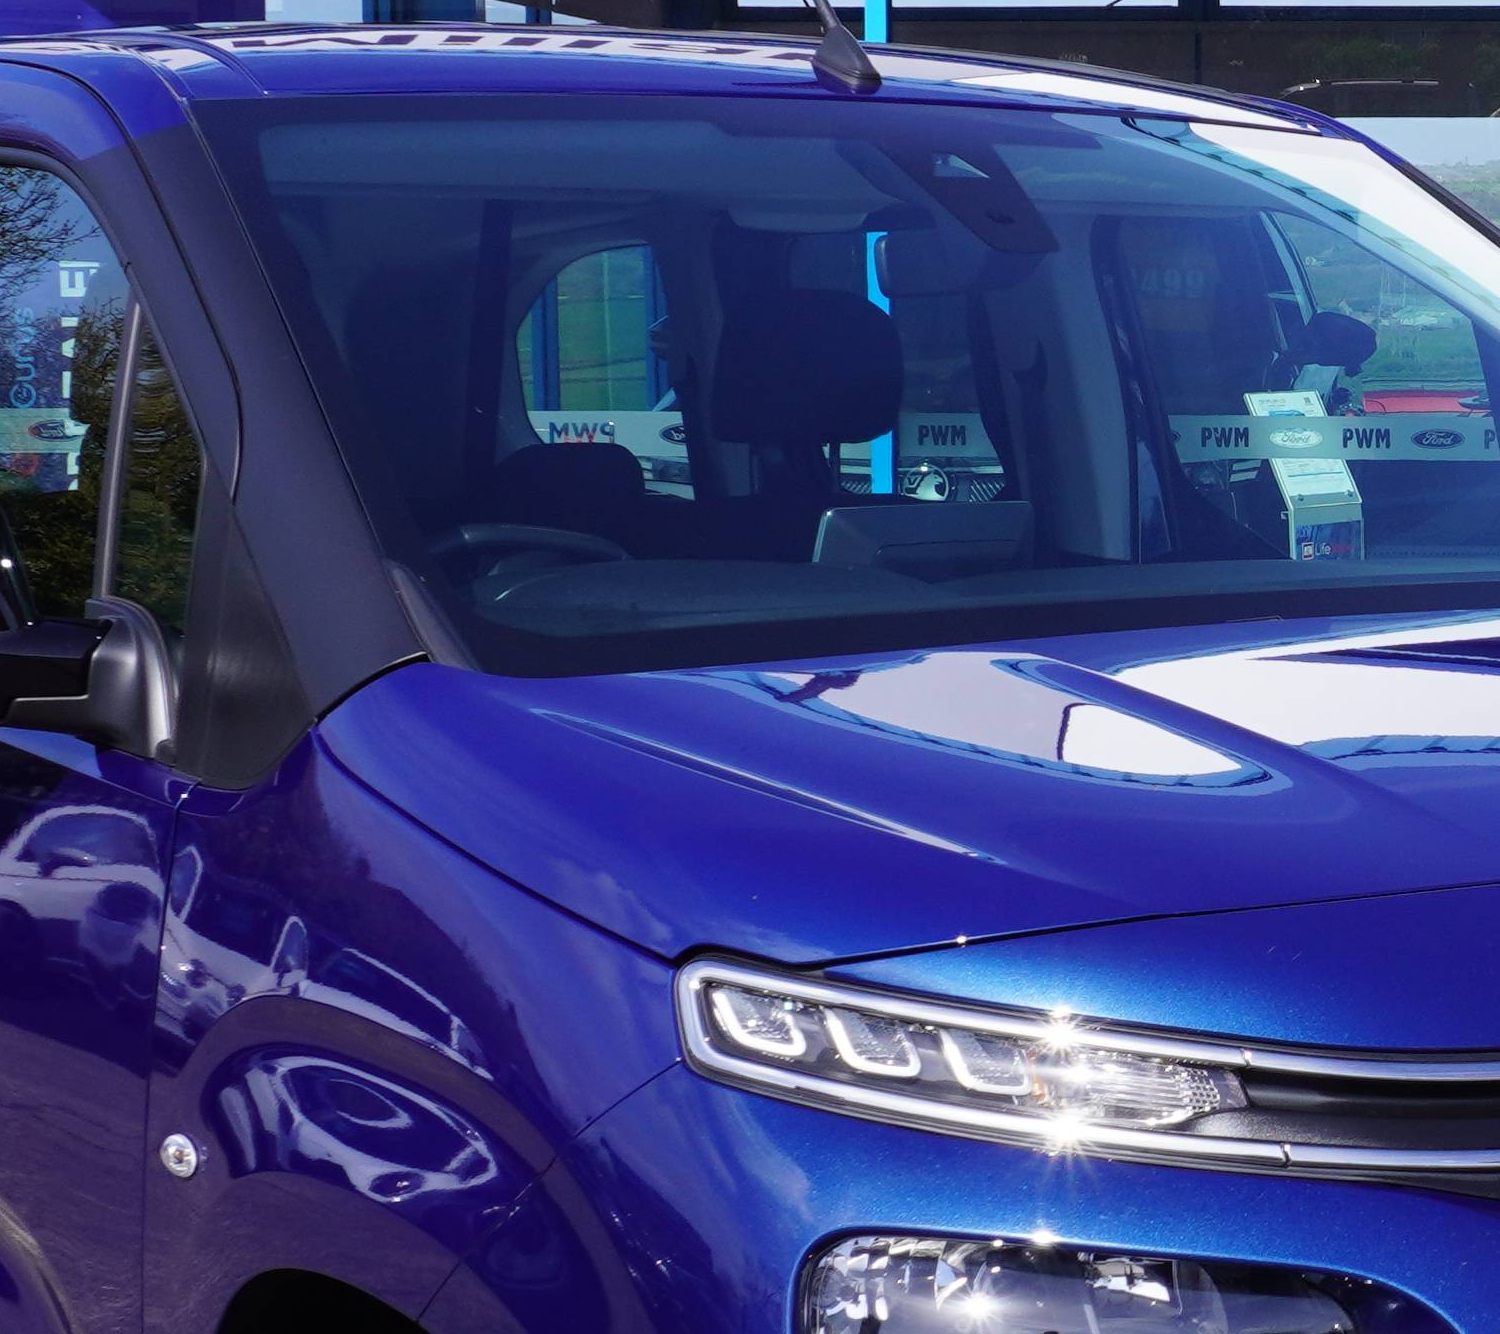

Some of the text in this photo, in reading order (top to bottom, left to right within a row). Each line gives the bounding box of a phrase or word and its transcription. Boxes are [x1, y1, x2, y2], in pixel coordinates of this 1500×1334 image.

[918, 424, 966, 446] PWM
[1201, 426, 1249, 447] PWM
[1342, 427, 1390, 449] PWM
